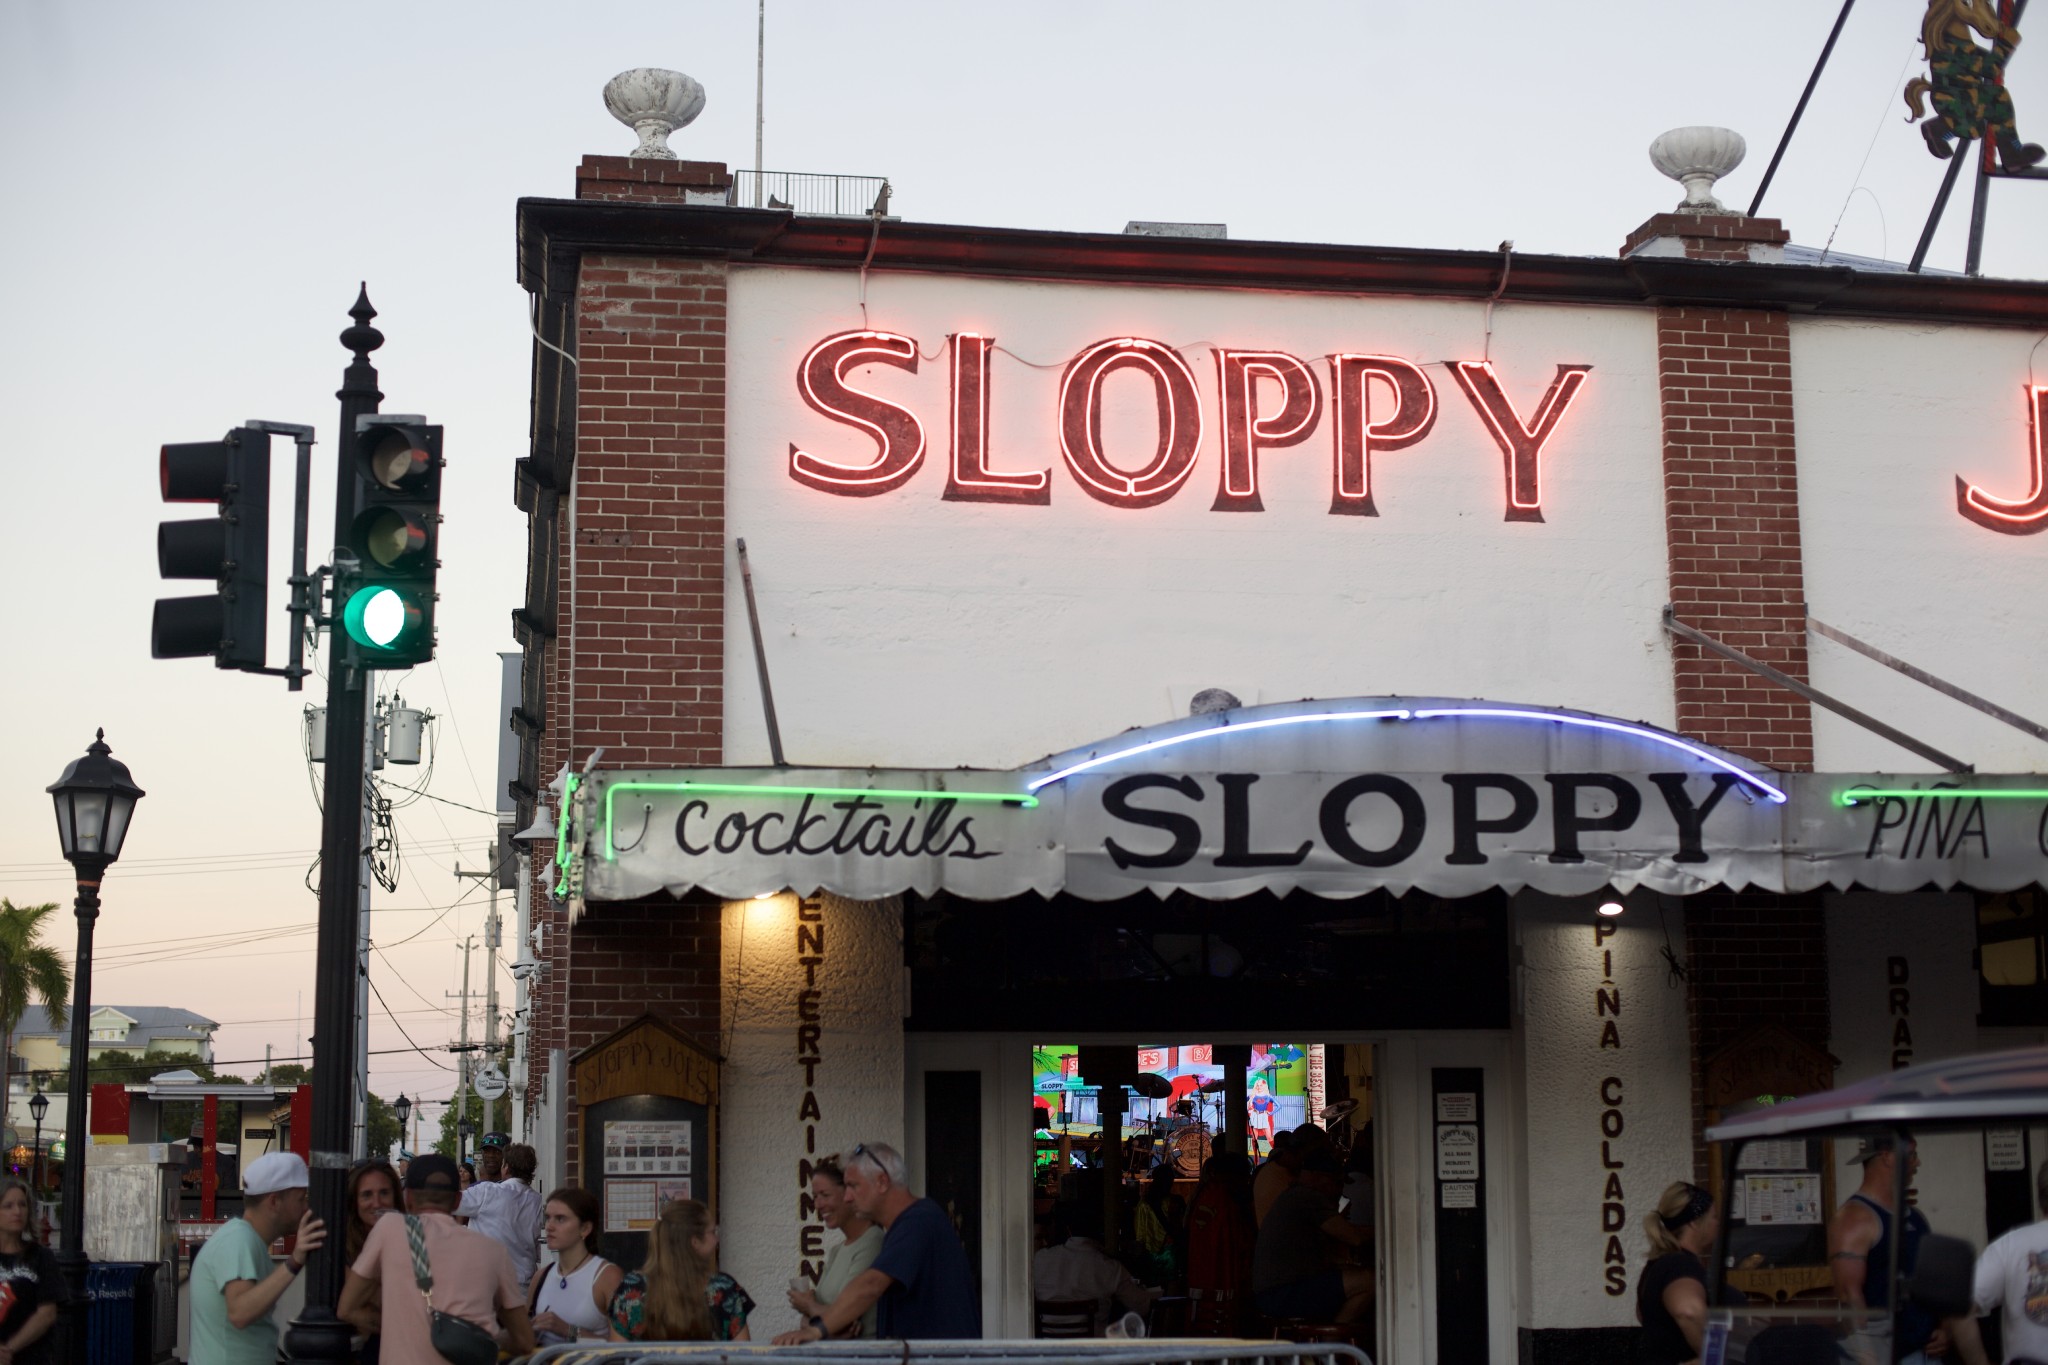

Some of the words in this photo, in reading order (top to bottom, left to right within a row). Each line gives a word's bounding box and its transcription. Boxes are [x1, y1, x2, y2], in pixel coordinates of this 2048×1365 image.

[789, 328, 1596, 524] SLOPPY
[676, 790, 1004, 860] Cocktails
[1102, 773, 1741, 870] SLOPPY
[1866, 781, 1990, 860] PIÑA
[1887, 956, 1913, 1071] DRAF
[583, 1040, 659, 1095] SLOPPY
[661, 1045, 711, 1096] JOE'S
[798, 892, 825, 1289] ENTERTAINMEN
[1041, 1082, 1064, 1091] SLOPPY
[1601, 1076, 1627, 1297] COLADAS
[99, 1288, 128, 1301] Recycle
